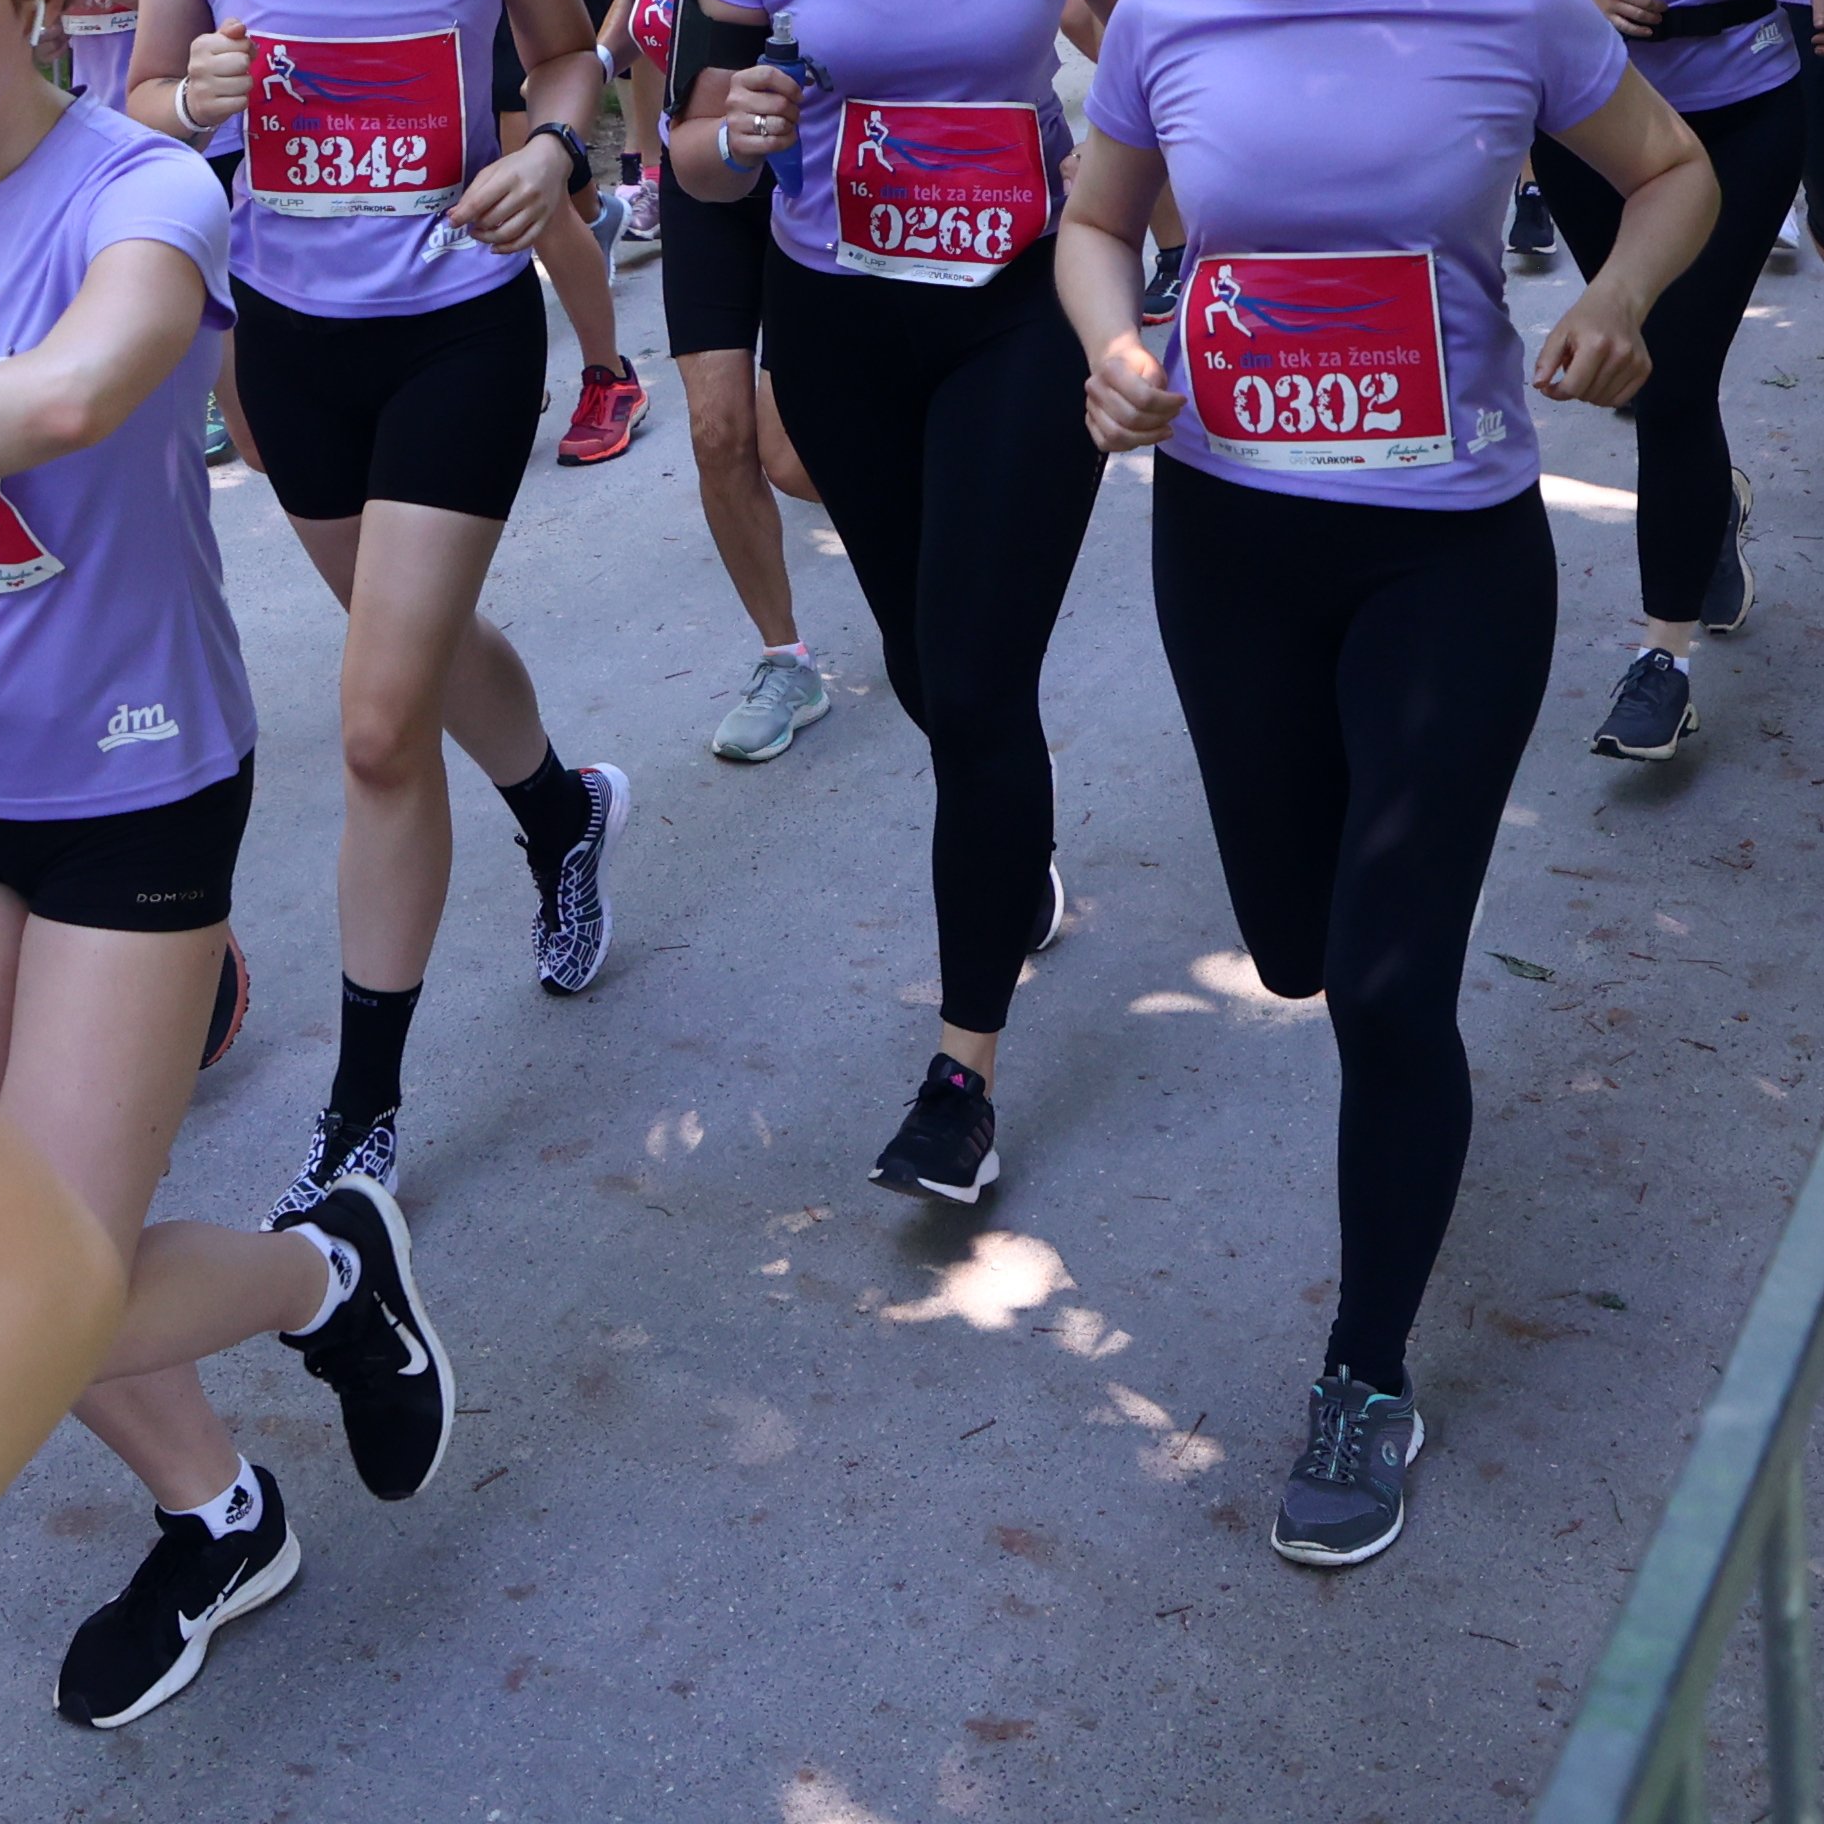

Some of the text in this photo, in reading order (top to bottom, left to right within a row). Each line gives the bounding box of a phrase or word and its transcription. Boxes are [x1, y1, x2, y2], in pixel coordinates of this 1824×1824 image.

[643, 35, 662, 47] 16.
[261, 114, 285, 132] 16.
[327, 113, 355, 131] tek
[360, 118, 381, 131] za
[386, 112, 448, 130] ženske
[285, 135, 428, 188] 3342
[280, 198, 304, 207] LPP
[850, 181, 874, 198] 16.
[914, 184, 942, 201] tek
[946, 188, 966, 201] za
[972, 185, 1033, 203] ženske
[869, 203, 1014, 260] 0268
[1205, 345, 1421, 370] 16. dm tek za ženske
[1233, 371, 1402, 434] 0302
[108, 703, 166, 736] dm
